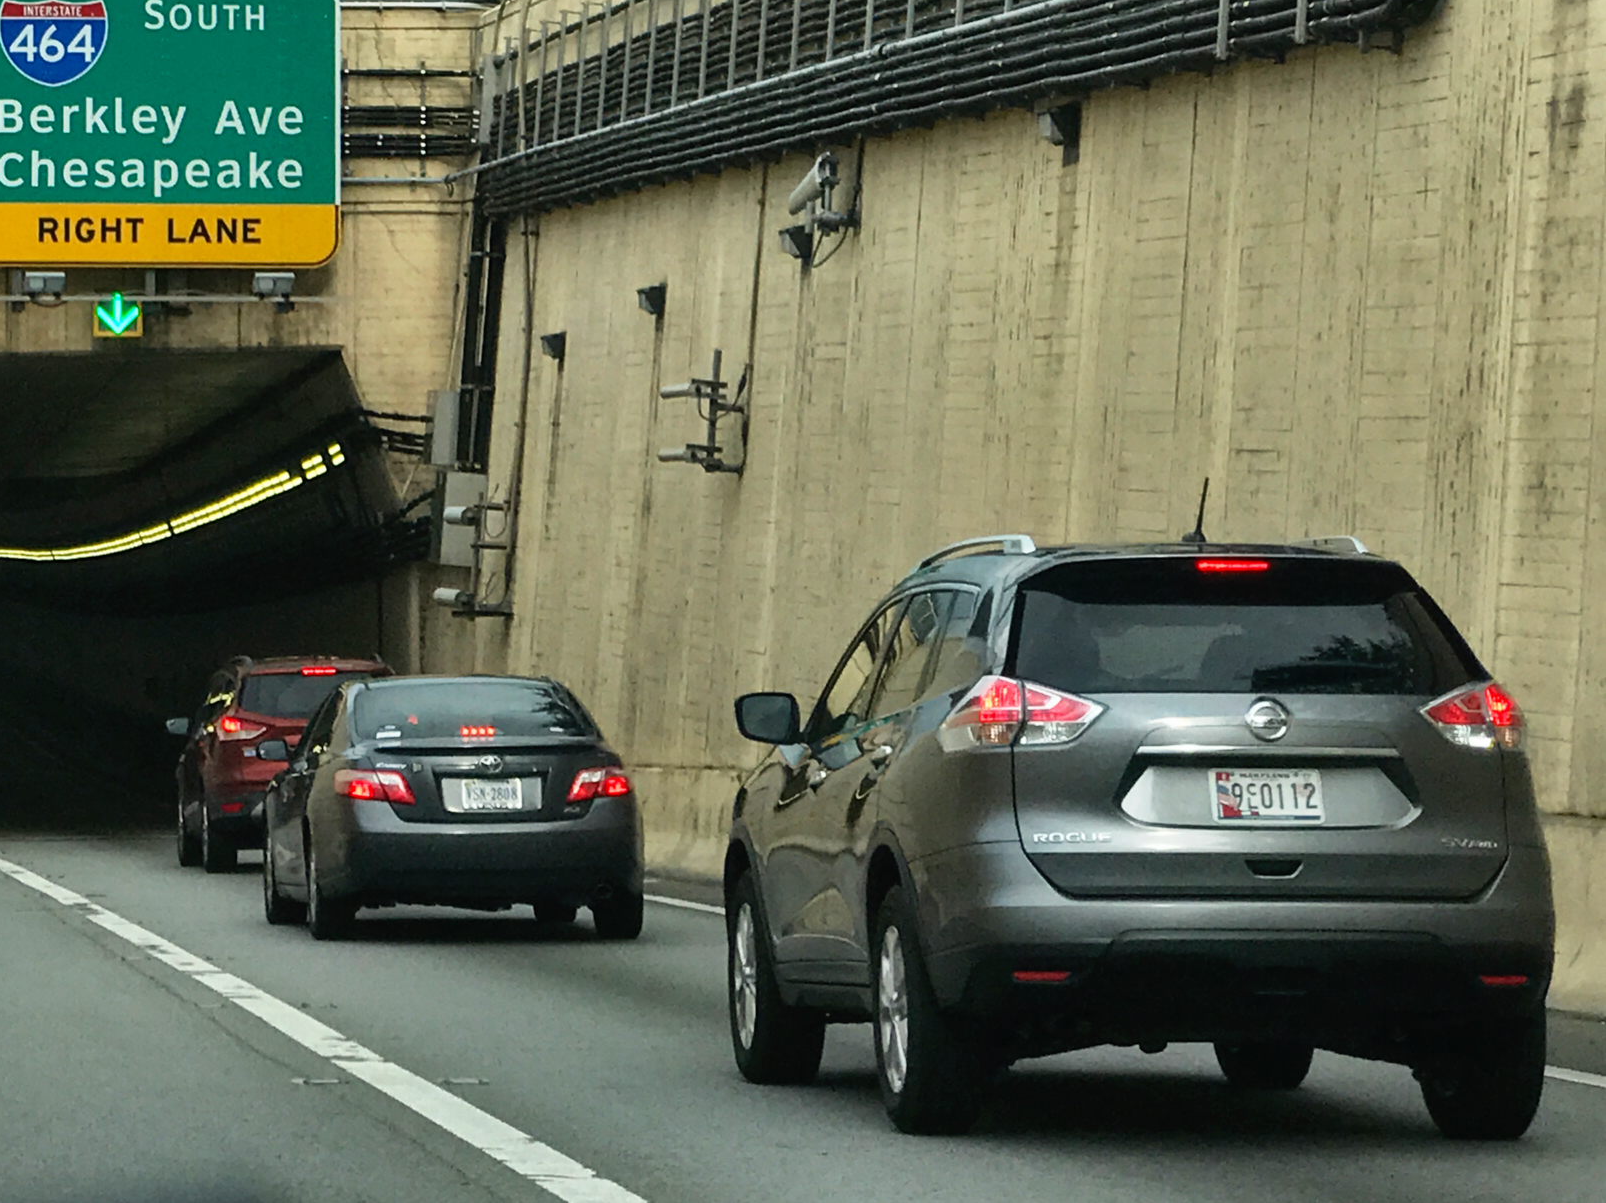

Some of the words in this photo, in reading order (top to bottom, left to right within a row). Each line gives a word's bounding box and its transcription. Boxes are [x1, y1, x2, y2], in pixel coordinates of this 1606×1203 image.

[23, 5, 82, 18] INTERSTATE
[9, 24, 96, 63] 464
[215, 100, 304, 135] Ave
[37, 217, 144, 244] RIGHT
[167, 217, 262, 244] LANE
[1033, 832, 1113, 843] ROGUE
